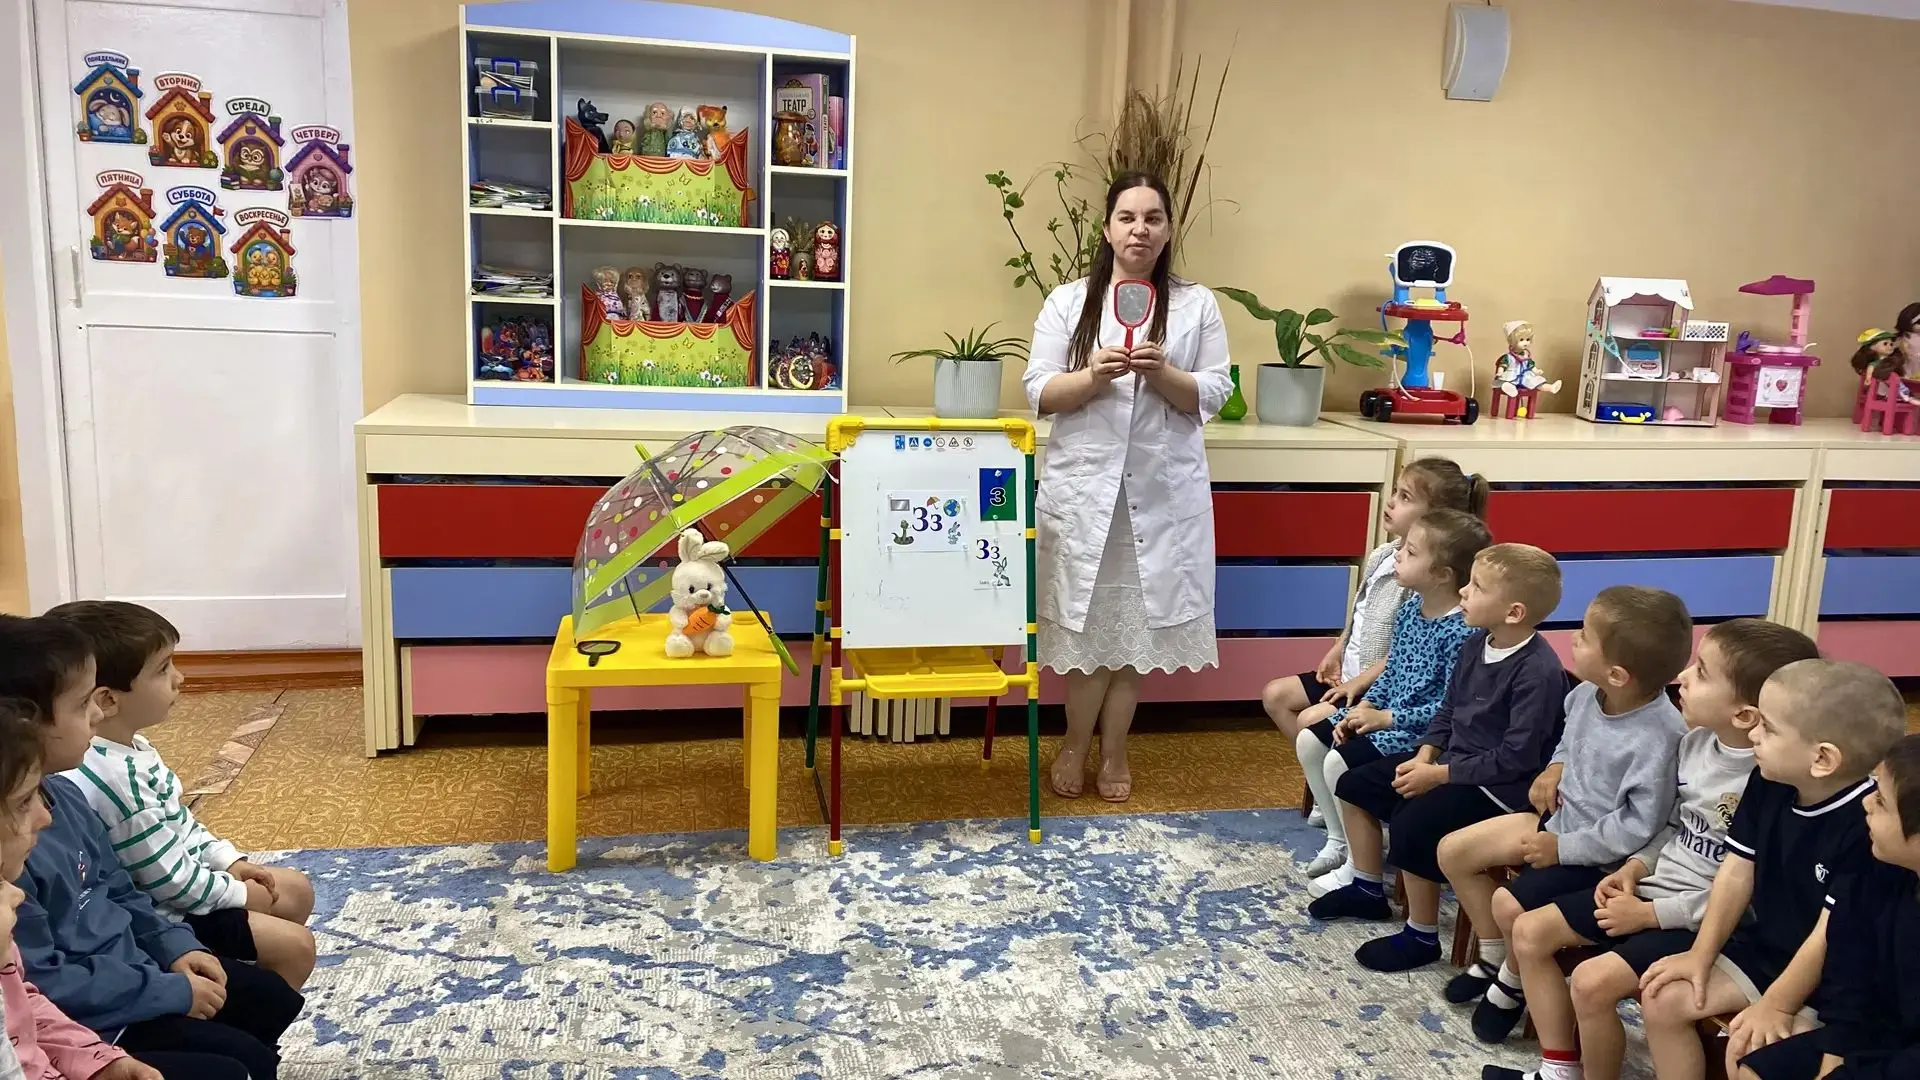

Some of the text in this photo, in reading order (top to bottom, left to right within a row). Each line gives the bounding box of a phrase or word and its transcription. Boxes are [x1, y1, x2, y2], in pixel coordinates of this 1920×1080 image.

[88, 55, 125, 65] ПОНЕДЕЛЬНИК
[159, 77, 198, 89] ВТОРНИК
[232, 101, 265, 113] СРЕДА
[782, 99, 807, 112] ТЕАТР
[296, 129, 338, 141] ЧЕТВЕРГ
[101, 173, 140, 186] ПЯТНИЦА
[172, 189, 211, 203] СУББОТА
[238, 211, 286, 224] ВОСКРЕСЕНЬЕ
